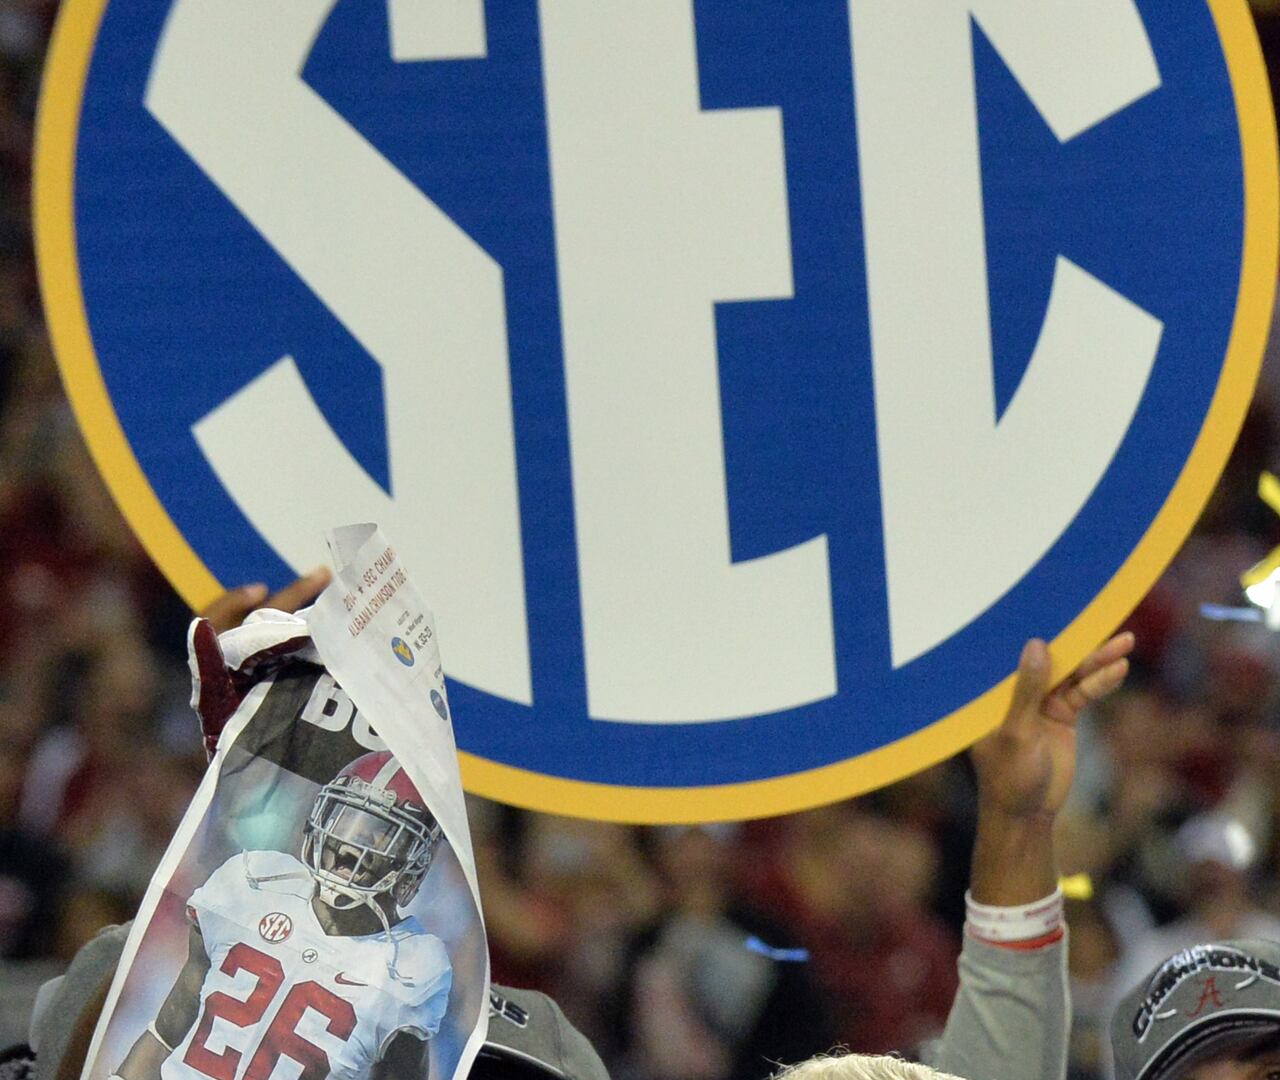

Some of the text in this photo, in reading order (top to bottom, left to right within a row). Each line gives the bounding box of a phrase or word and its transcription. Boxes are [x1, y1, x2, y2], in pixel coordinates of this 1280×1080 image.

[145, 0, 1164, 724] SEC
[362, 567, 378, 588] SEC
[348, 610, 374, 640] ALABAMA
[368, 582, 396, 616] CRIMSON
